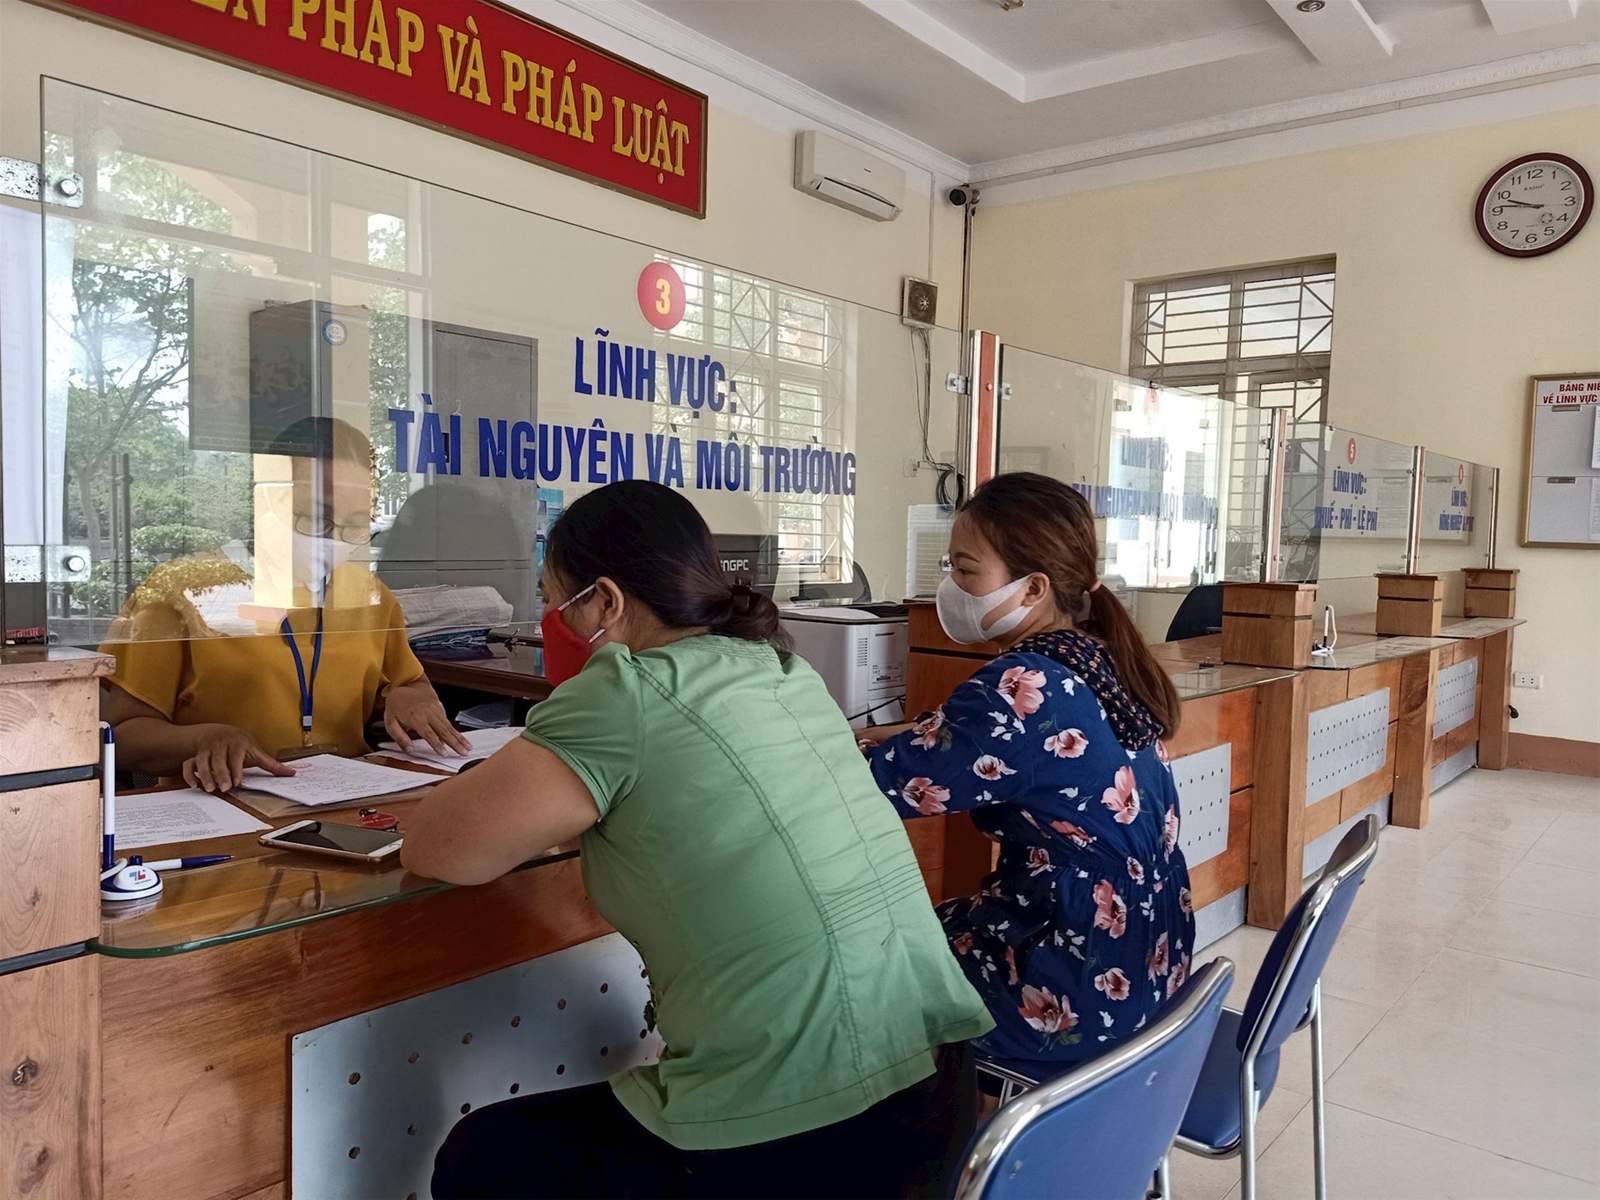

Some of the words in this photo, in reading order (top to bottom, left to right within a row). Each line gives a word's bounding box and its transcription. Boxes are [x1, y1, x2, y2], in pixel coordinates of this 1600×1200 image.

[437, 15, 491, 106] VÀ
[501, 59, 604, 143] PHÁP
[612, 98, 690, 184] LUẬT
[1527, 168, 1543, 180] 12
[1552, 170, 1557, 180] 1
[1511, 176, 1521, 186] 11
[1560, 181, 1572, 191] 2
[1497, 190, 1511, 200] 10
[1564, 196, 1576, 206] 3
[1492, 206, 1503, 216] 9
[1556, 213, 1570, 222] 4
[1497, 221, 1508, 230] 8
[1510, 229, 1520, 239] 7
[1543, 226, 1555, 236] 5
[1525, 233, 1537, 243] 6
[655, 278, 671, 315] 3
[575, 327, 656, 402] LĨNH
[666, 354, 737, 419] VỰC:
[388, 393, 461, 475] TÀI
[478, 418, 634, 484] NGUYÊN
[645, 423, 684, 488] VÀ
[696, 432, 750, 491] MÔI
[760, 436, 856, 495] TRƯỜNG
